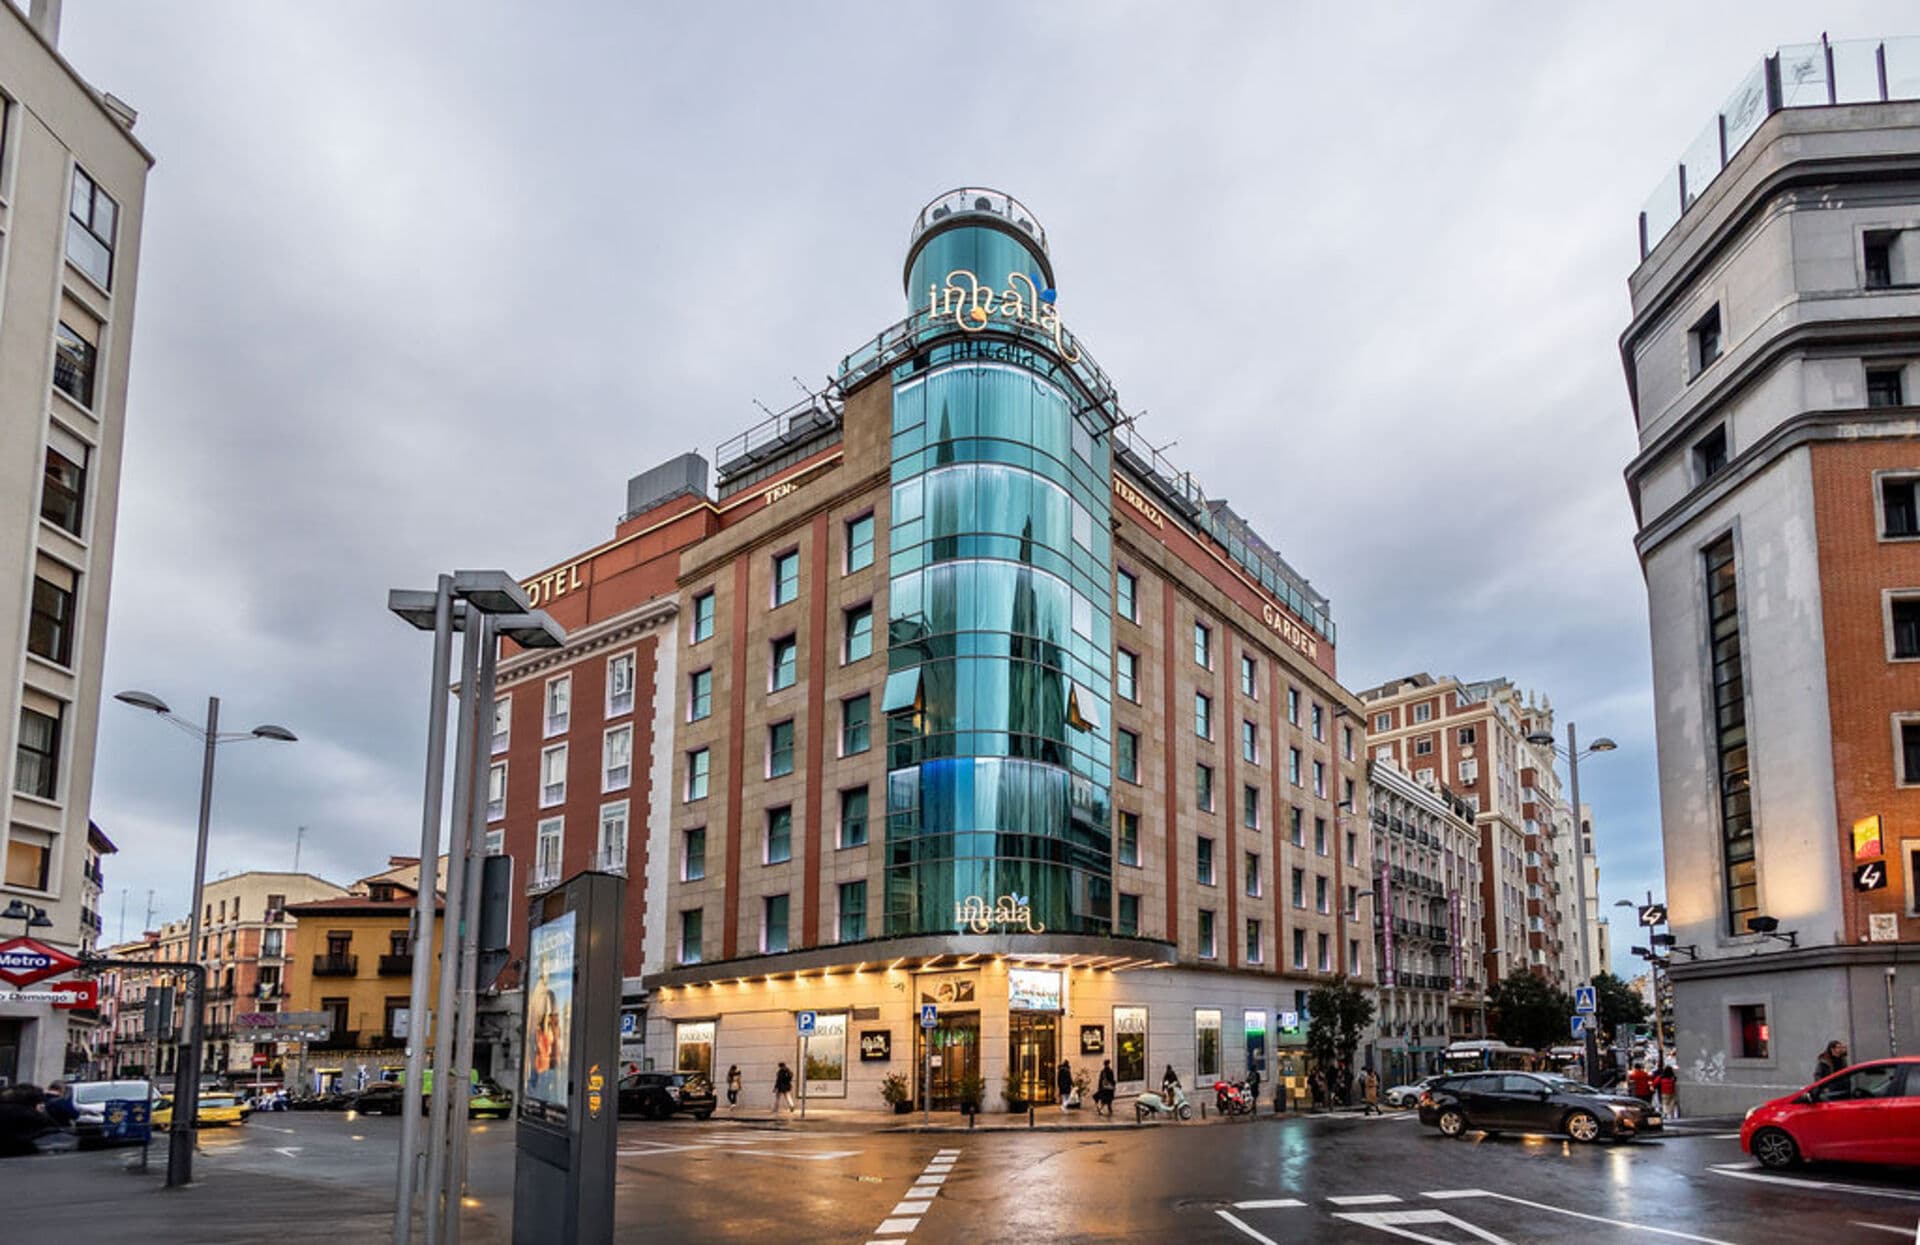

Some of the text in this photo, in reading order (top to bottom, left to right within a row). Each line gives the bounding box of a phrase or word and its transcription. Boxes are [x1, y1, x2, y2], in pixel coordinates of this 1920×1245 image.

[928, 269, 1081, 363] inhala
[1114, 477, 1164, 529] TERRAZA
[526, 565, 583, 609] OTEL
[1263, 604, 1318, 660] GARDEN
[955, 895, 1046, 934] inhala
[0, 955, 47, 966] Metro
[801, 1013, 812, 1028] P
